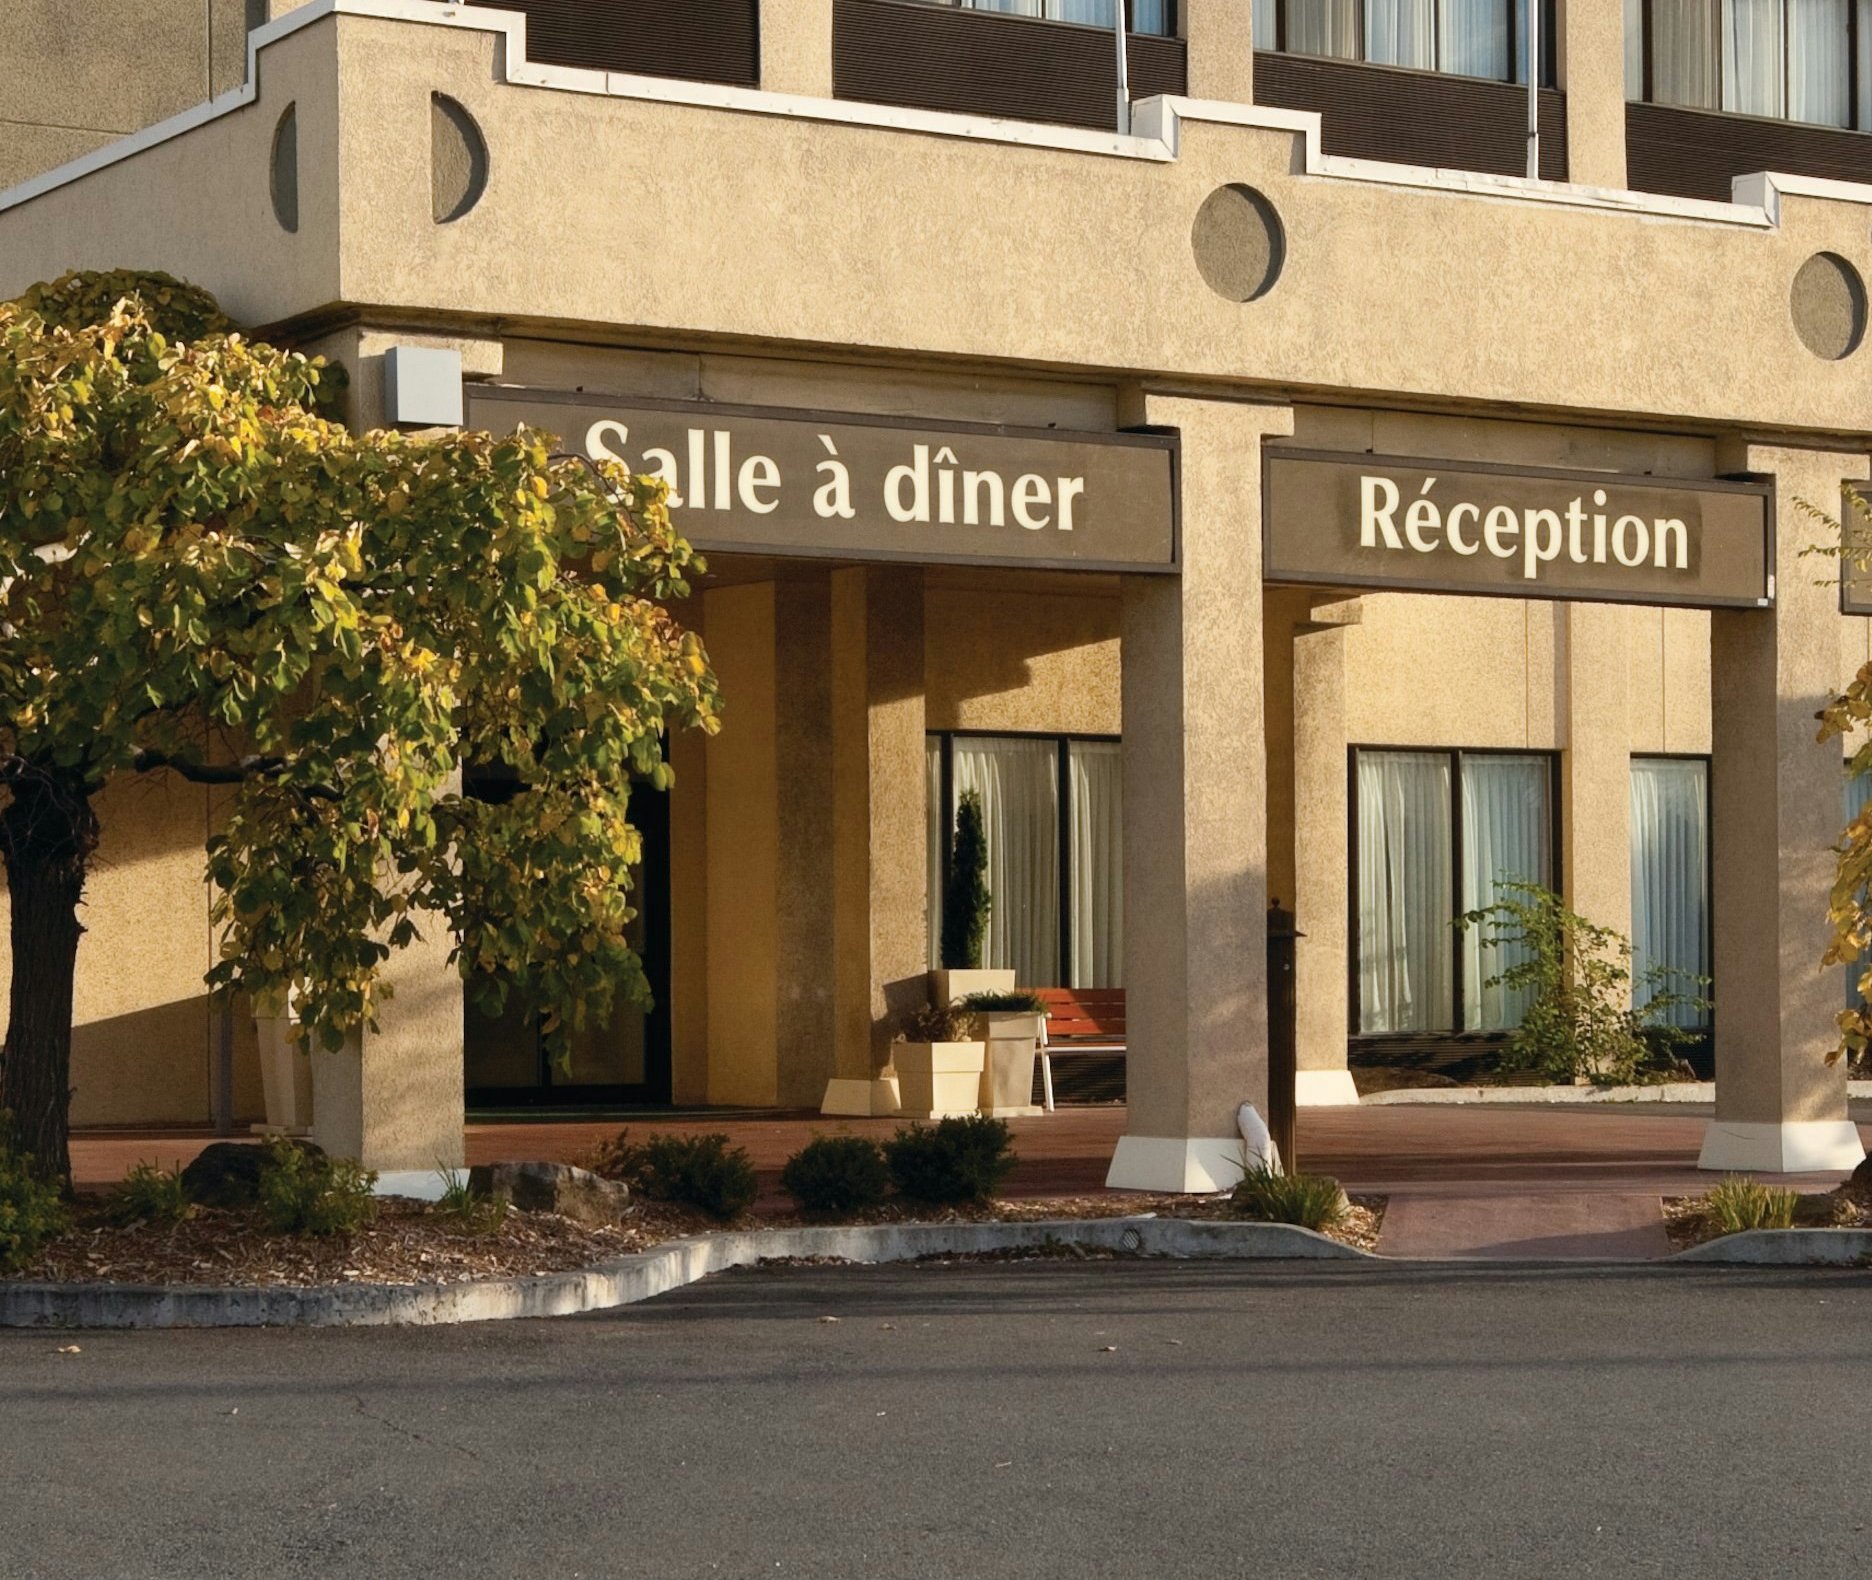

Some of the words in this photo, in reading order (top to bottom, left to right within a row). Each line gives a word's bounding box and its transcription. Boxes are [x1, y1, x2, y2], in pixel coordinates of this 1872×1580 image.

[585, 419, 782, 514] Salle
[812, 433, 856, 520] à
[883, 443, 1085, 532] dîner
[1358, 475, 1690, 579] Réception
